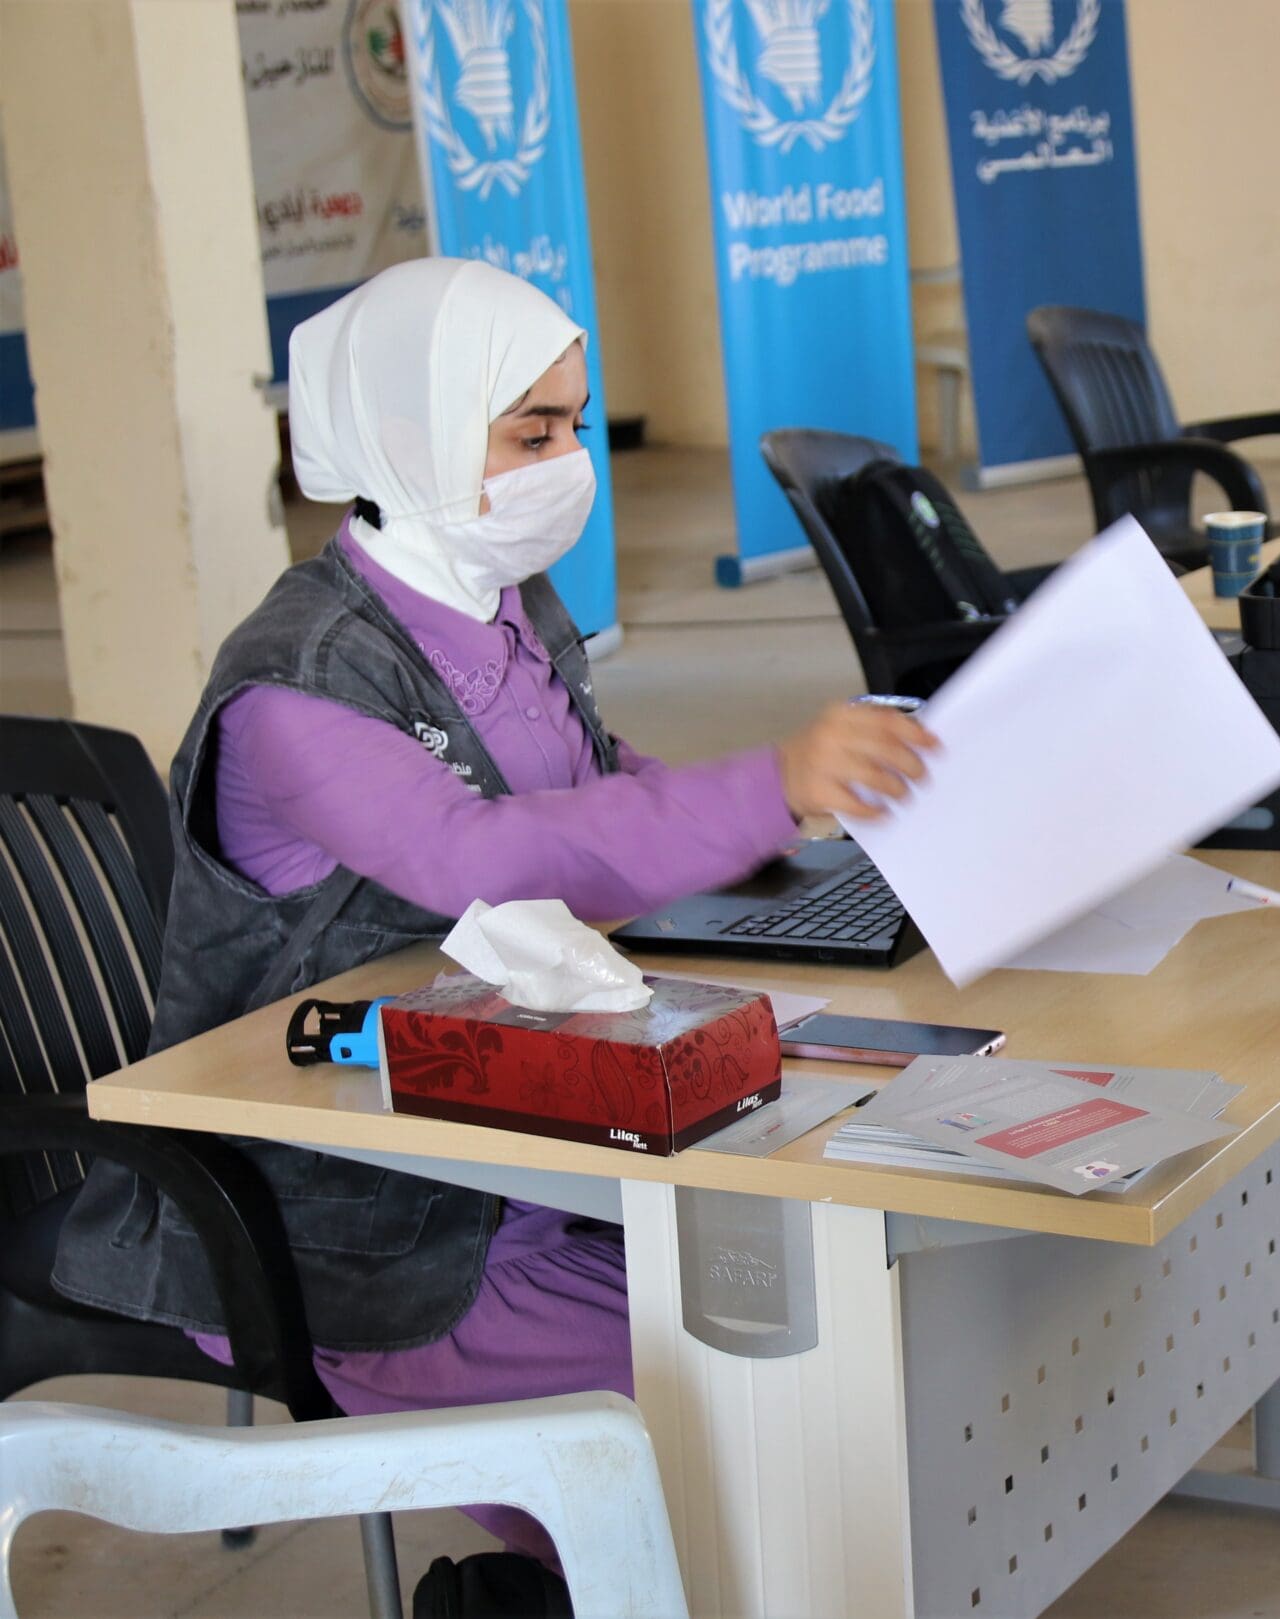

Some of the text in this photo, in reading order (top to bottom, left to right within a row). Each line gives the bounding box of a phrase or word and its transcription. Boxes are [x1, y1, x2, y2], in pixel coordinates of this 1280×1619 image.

[1048, 105, 1111, 146] برنامج
[722, 177, 885, 231] World Food
[728, 235, 889, 288] Programme
[737, 1093, 759, 1112] Lilas
[609, 1128, 640, 1142] Lilas
